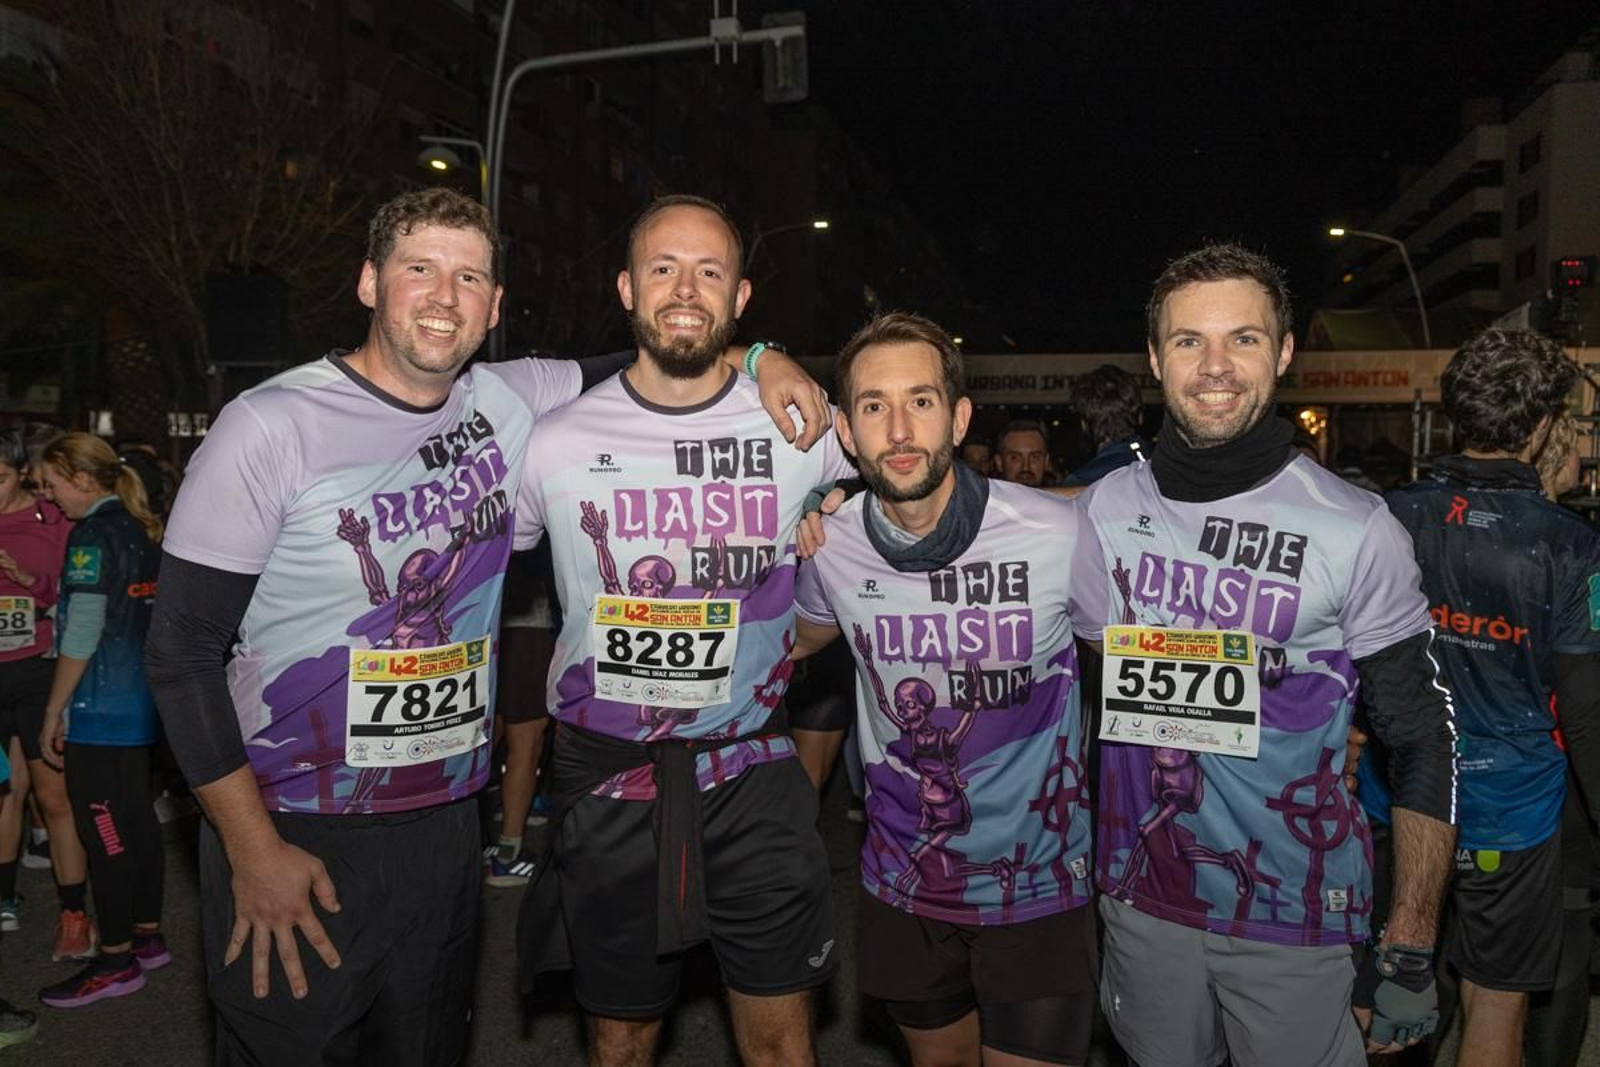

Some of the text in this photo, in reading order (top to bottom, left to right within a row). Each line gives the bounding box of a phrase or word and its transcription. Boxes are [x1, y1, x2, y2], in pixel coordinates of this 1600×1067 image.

[965, 374, 1037, 391] URBANA
[1303, 371, 1340, 390] SAN
[1343, 370, 1409, 389] ANTON
[421, 412, 492, 468] THE
[675, 440, 770, 475] THE
[375, 445, 502, 537] LAST
[617, 487, 775, 537] LAST
[1202, 518, 1305, 575] THE
[930, 563, 1026, 602] THE
[1138, 554, 1298, 637] LAST
[625, 603, 650, 621] 42
[606, 628, 725, 668] 8287
[878, 612, 1030, 661] LAST
[1139, 633, 1166, 653] 42
[389, 656, 418, 676] 42
[669, 670, 699, 679] MORALES
[1117, 659, 1245, 707] 5570
[365, 671, 477, 722] 7821
[951, 669, 1030, 706] RUN
[1143, 703, 1167, 713] RAFAEL
[394, 725, 422, 735] ARTURO
